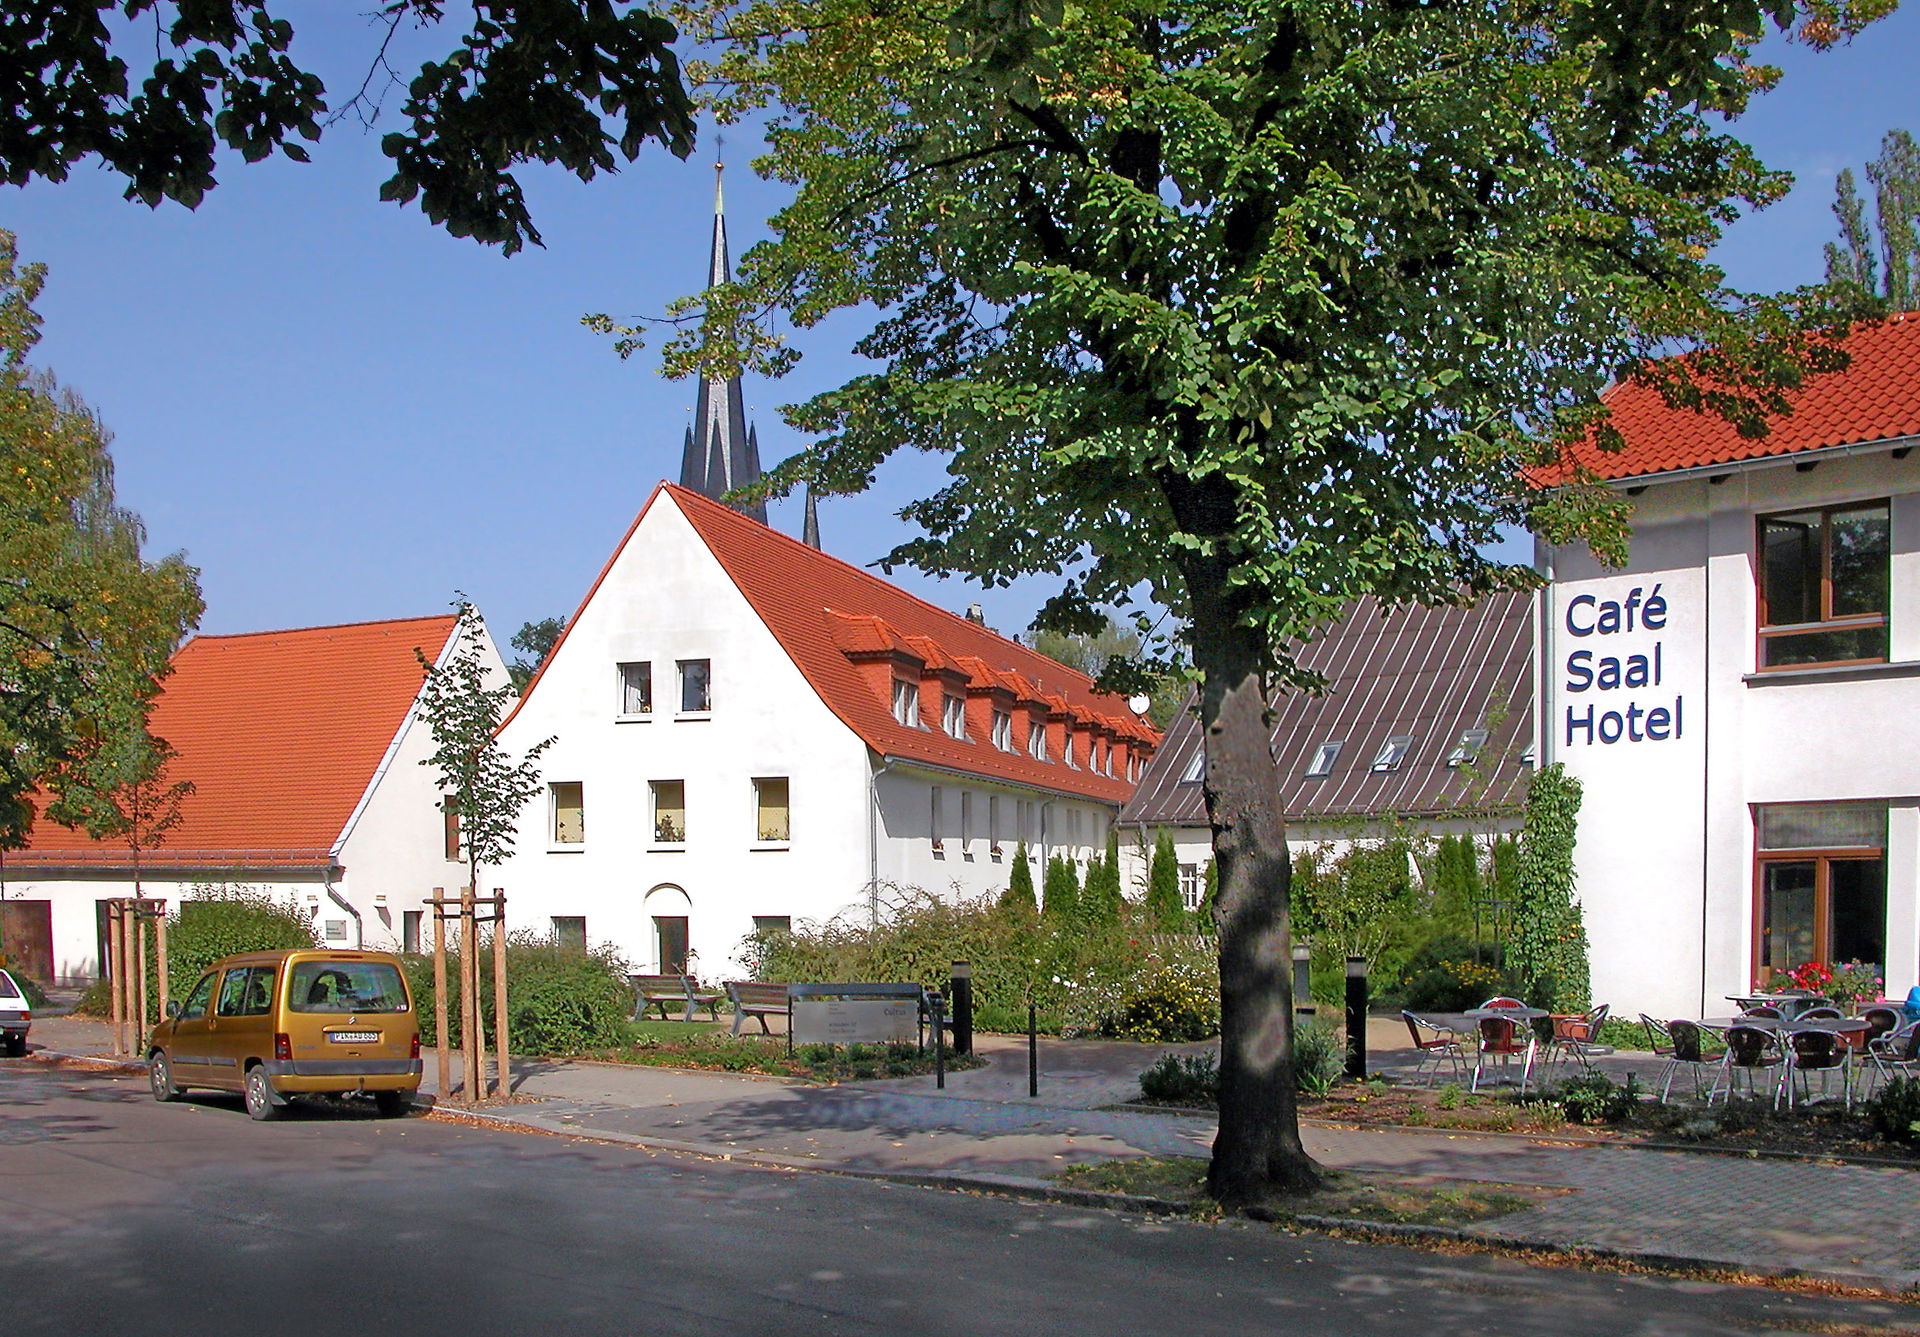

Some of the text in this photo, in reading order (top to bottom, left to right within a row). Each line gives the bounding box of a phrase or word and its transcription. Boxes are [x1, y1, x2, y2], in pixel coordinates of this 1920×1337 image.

[1566, 583, 1667, 637] Café
[1566, 642, 1661, 693] Saal
[1566, 695, 1682, 747] Hotel
